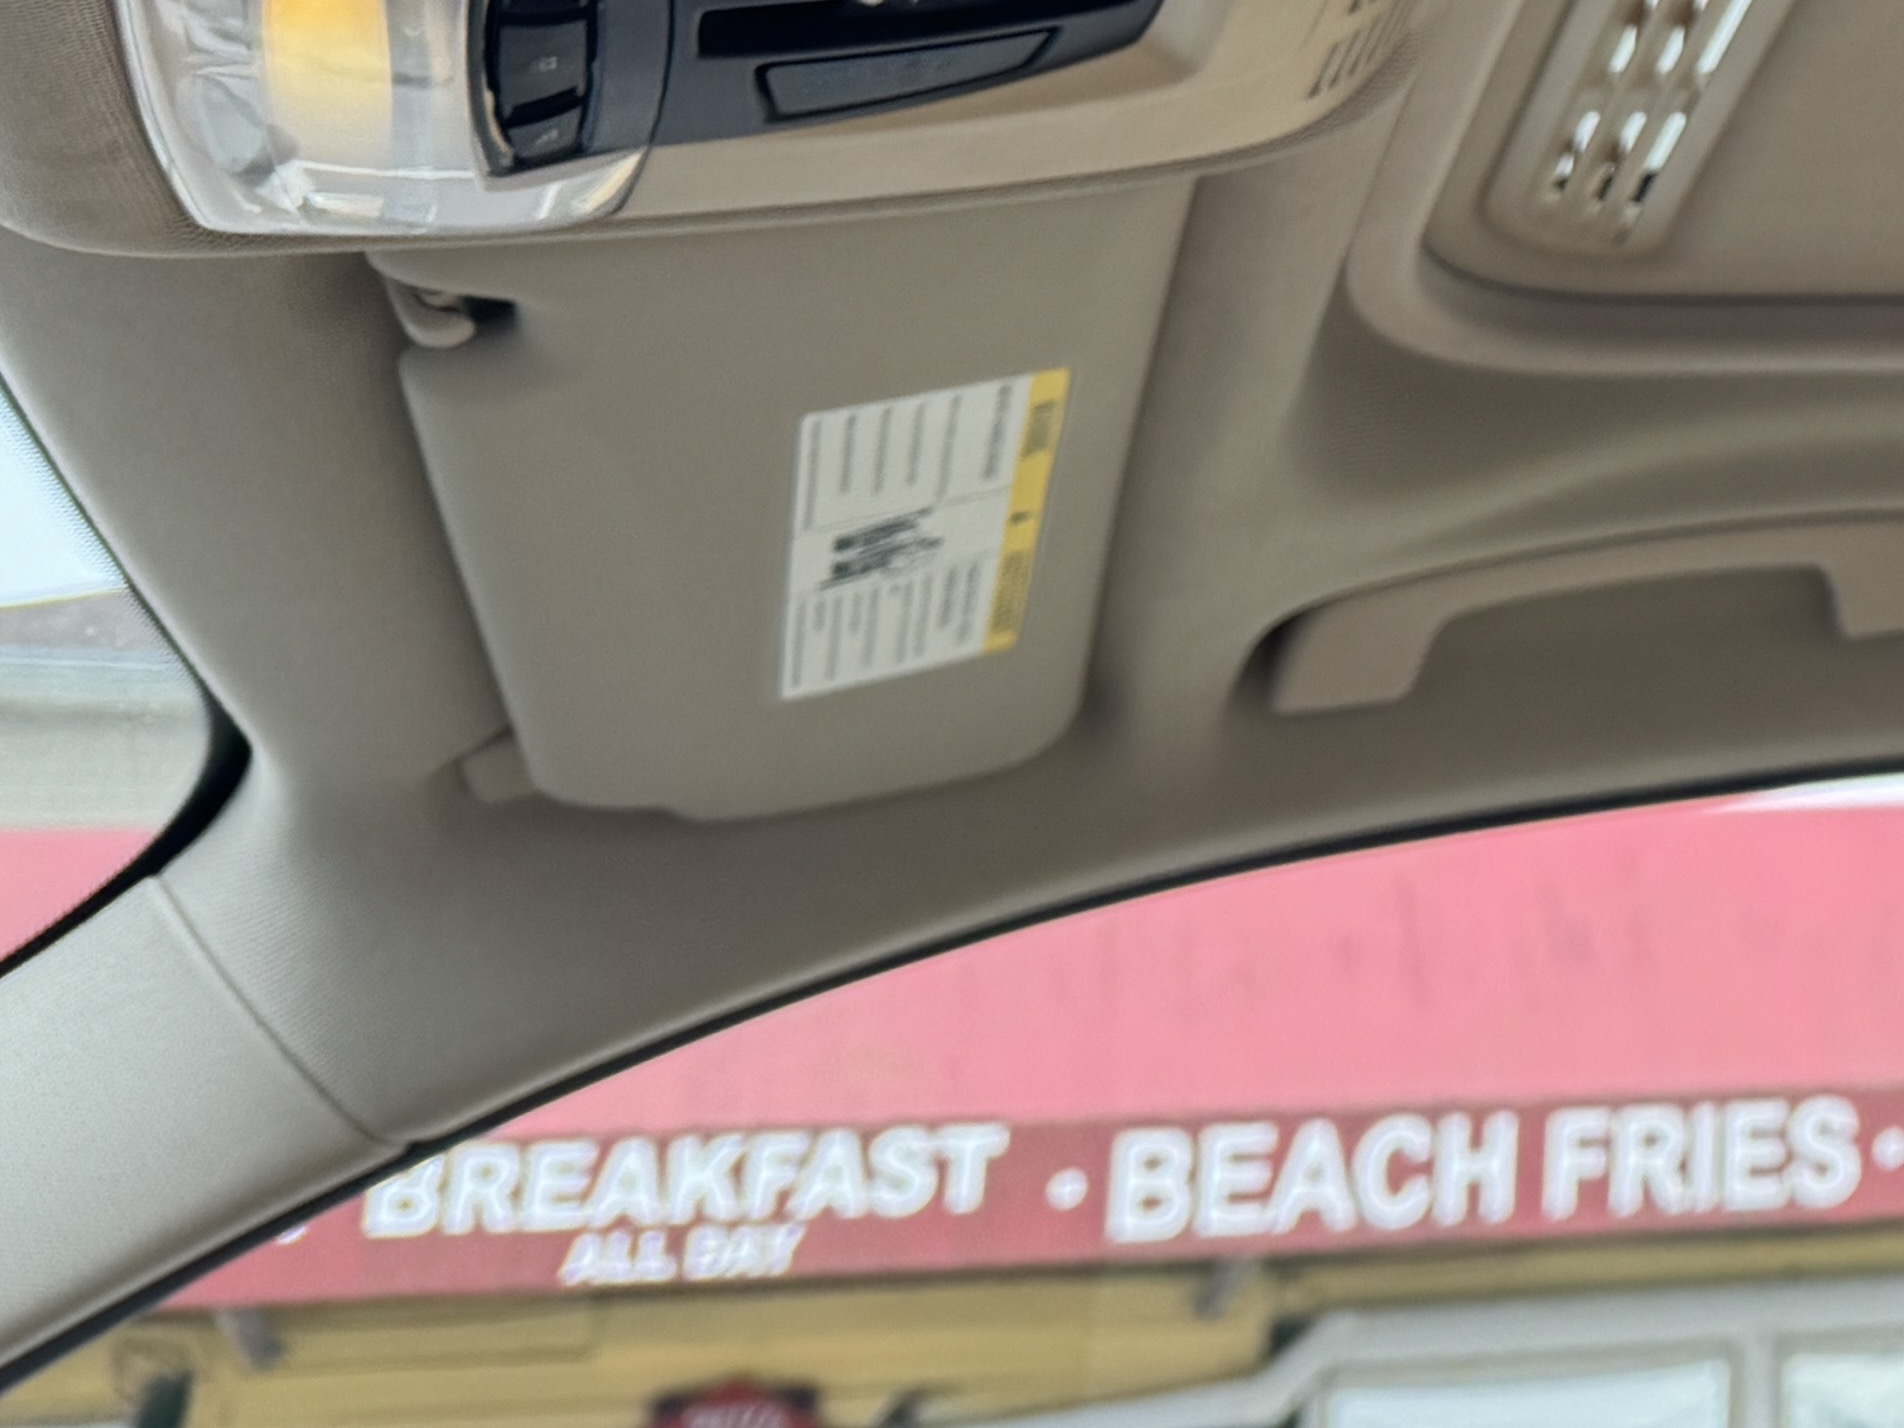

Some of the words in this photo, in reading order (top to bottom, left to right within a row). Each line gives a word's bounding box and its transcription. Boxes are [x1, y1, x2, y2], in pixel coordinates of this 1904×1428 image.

[362, 1124, 1010, 1236] BREAKFAST
[1105, 1110, 1518, 1242] BEACH
[1541, 1095, 1860, 1221] FRIES
[557, 1228, 678, 1286] ALL
